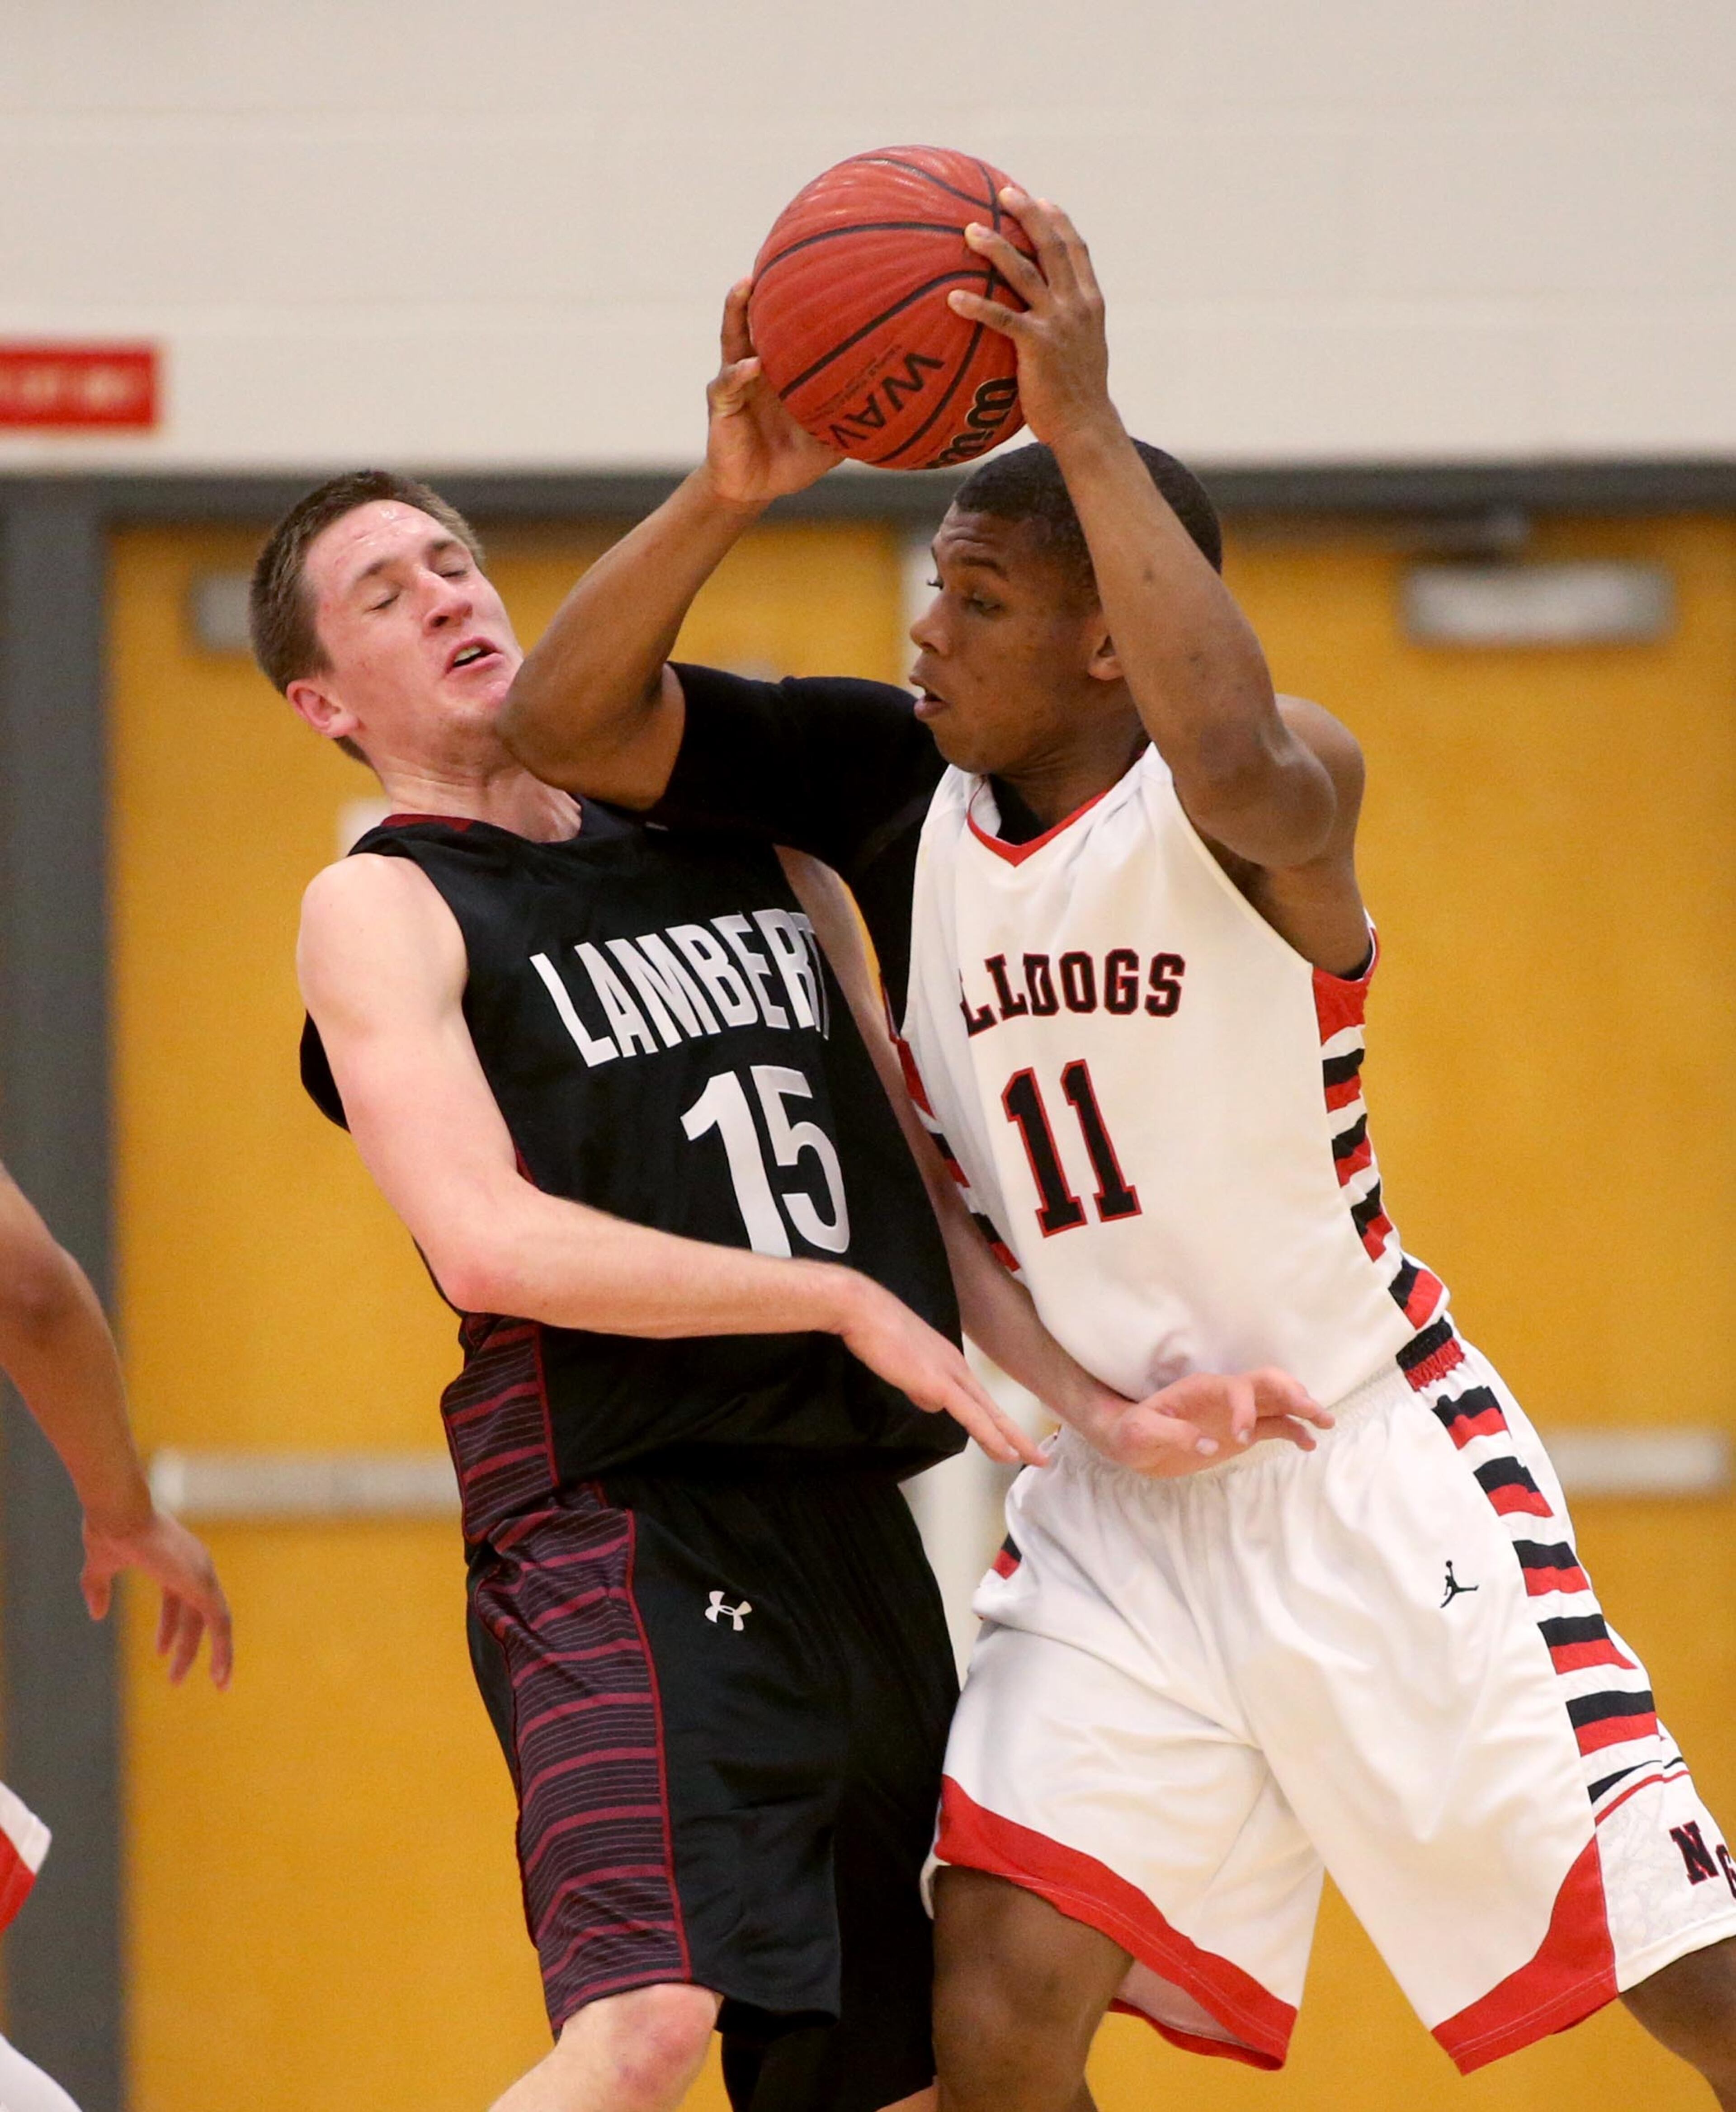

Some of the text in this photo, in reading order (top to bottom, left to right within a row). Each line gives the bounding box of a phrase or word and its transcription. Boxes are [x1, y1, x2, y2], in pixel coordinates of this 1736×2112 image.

[808, 353, 945, 449] WAV
[680, 1065, 850, 1258] 15
[1001, 1058, 1143, 1238] 11
